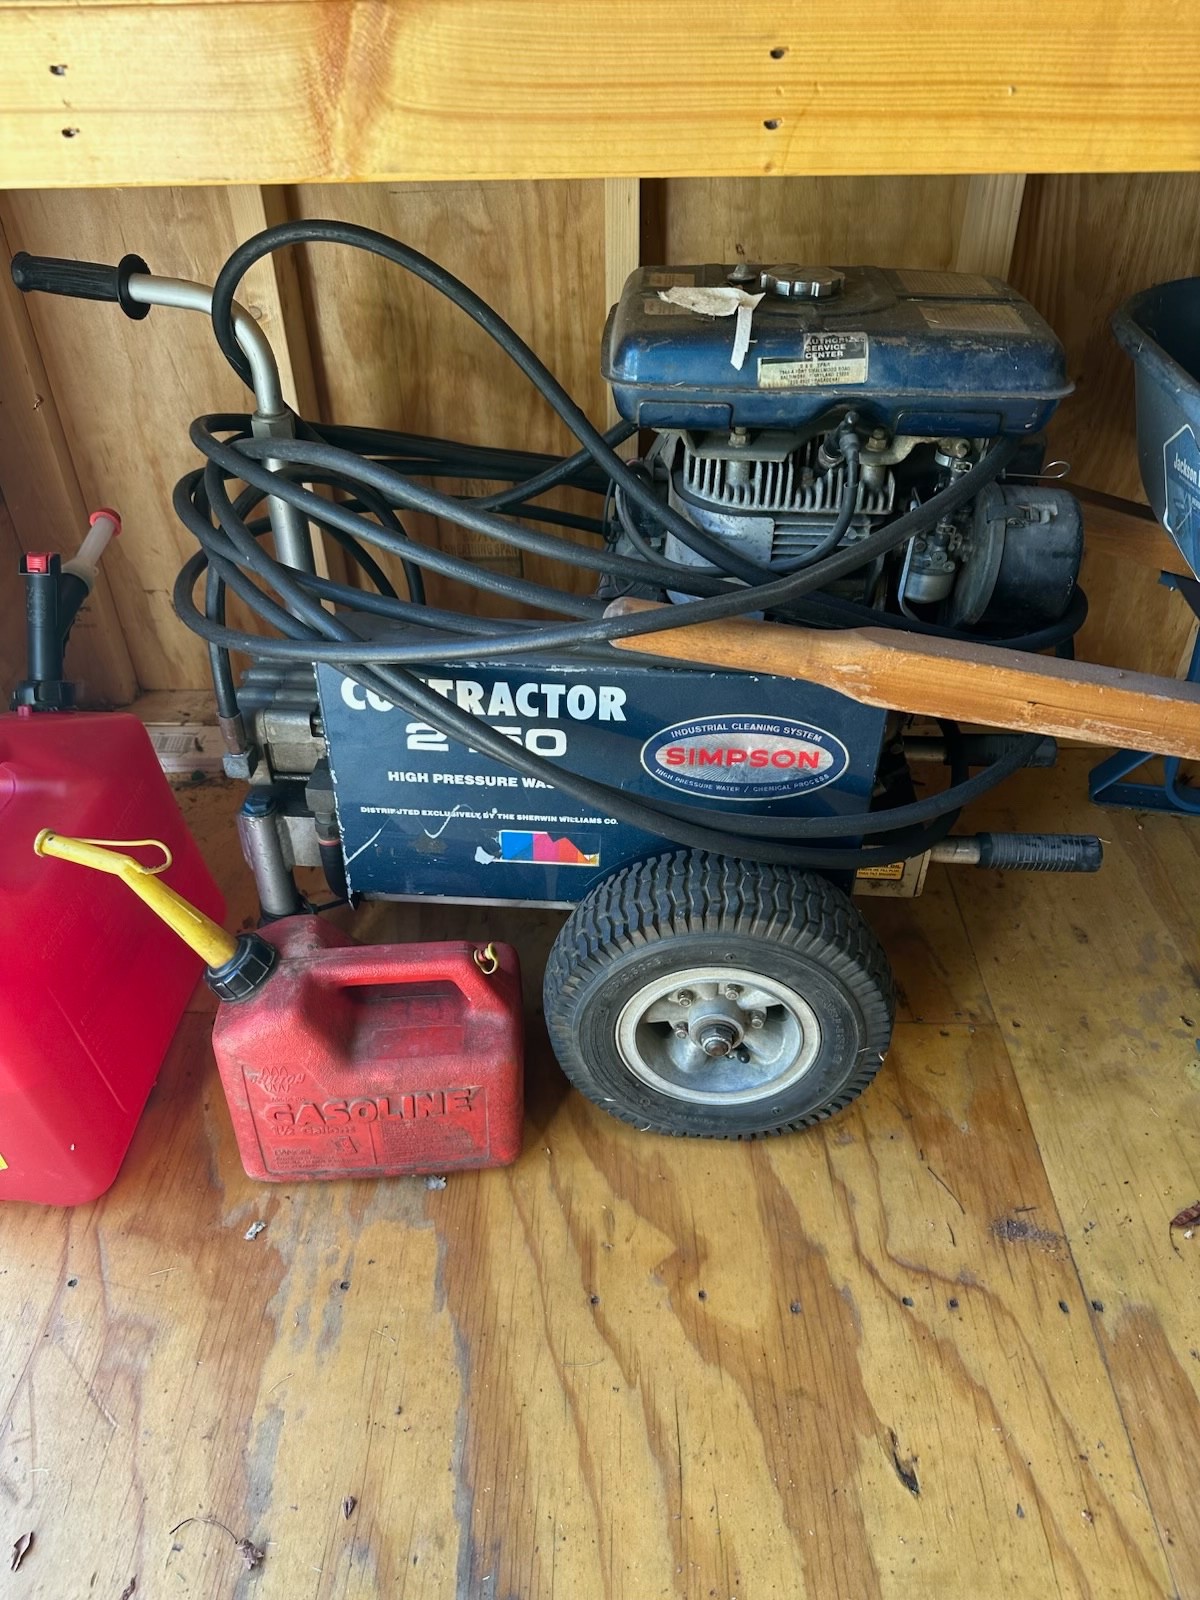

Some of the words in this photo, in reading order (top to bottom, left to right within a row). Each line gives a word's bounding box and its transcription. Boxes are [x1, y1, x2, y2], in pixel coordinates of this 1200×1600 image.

[805, 351, 844, 359] CENTER
[1173, 452, 1197, 485] Jackson
[405, 722, 567, 757] 20
[671, 723, 729, 739] INDUSTRIAL
[731, 722, 781, 733] CLEANING
[783, 726, 823, 743] SYSTEM
[665, 746, 820, 770] SIMPSON
[388, 770, 429, 783] HIGH
[432, 773, 519, 788] PRESSURE
[655, 768, 674, 781] HIGH
[674, 776, 713, 790] PRESSURE
[715, 784, 741, 793] WATER
[752, 784, 792, 793] CHEMICAL
[793, 773, 830, 789] PROCESS
[496, 813, 515, 821] THE
[516, 814, 558, 823] SHERWIN
[558, 815, 603, 825] WILLIAMS
[264, 1088, 474, 1125] GASOLINE
